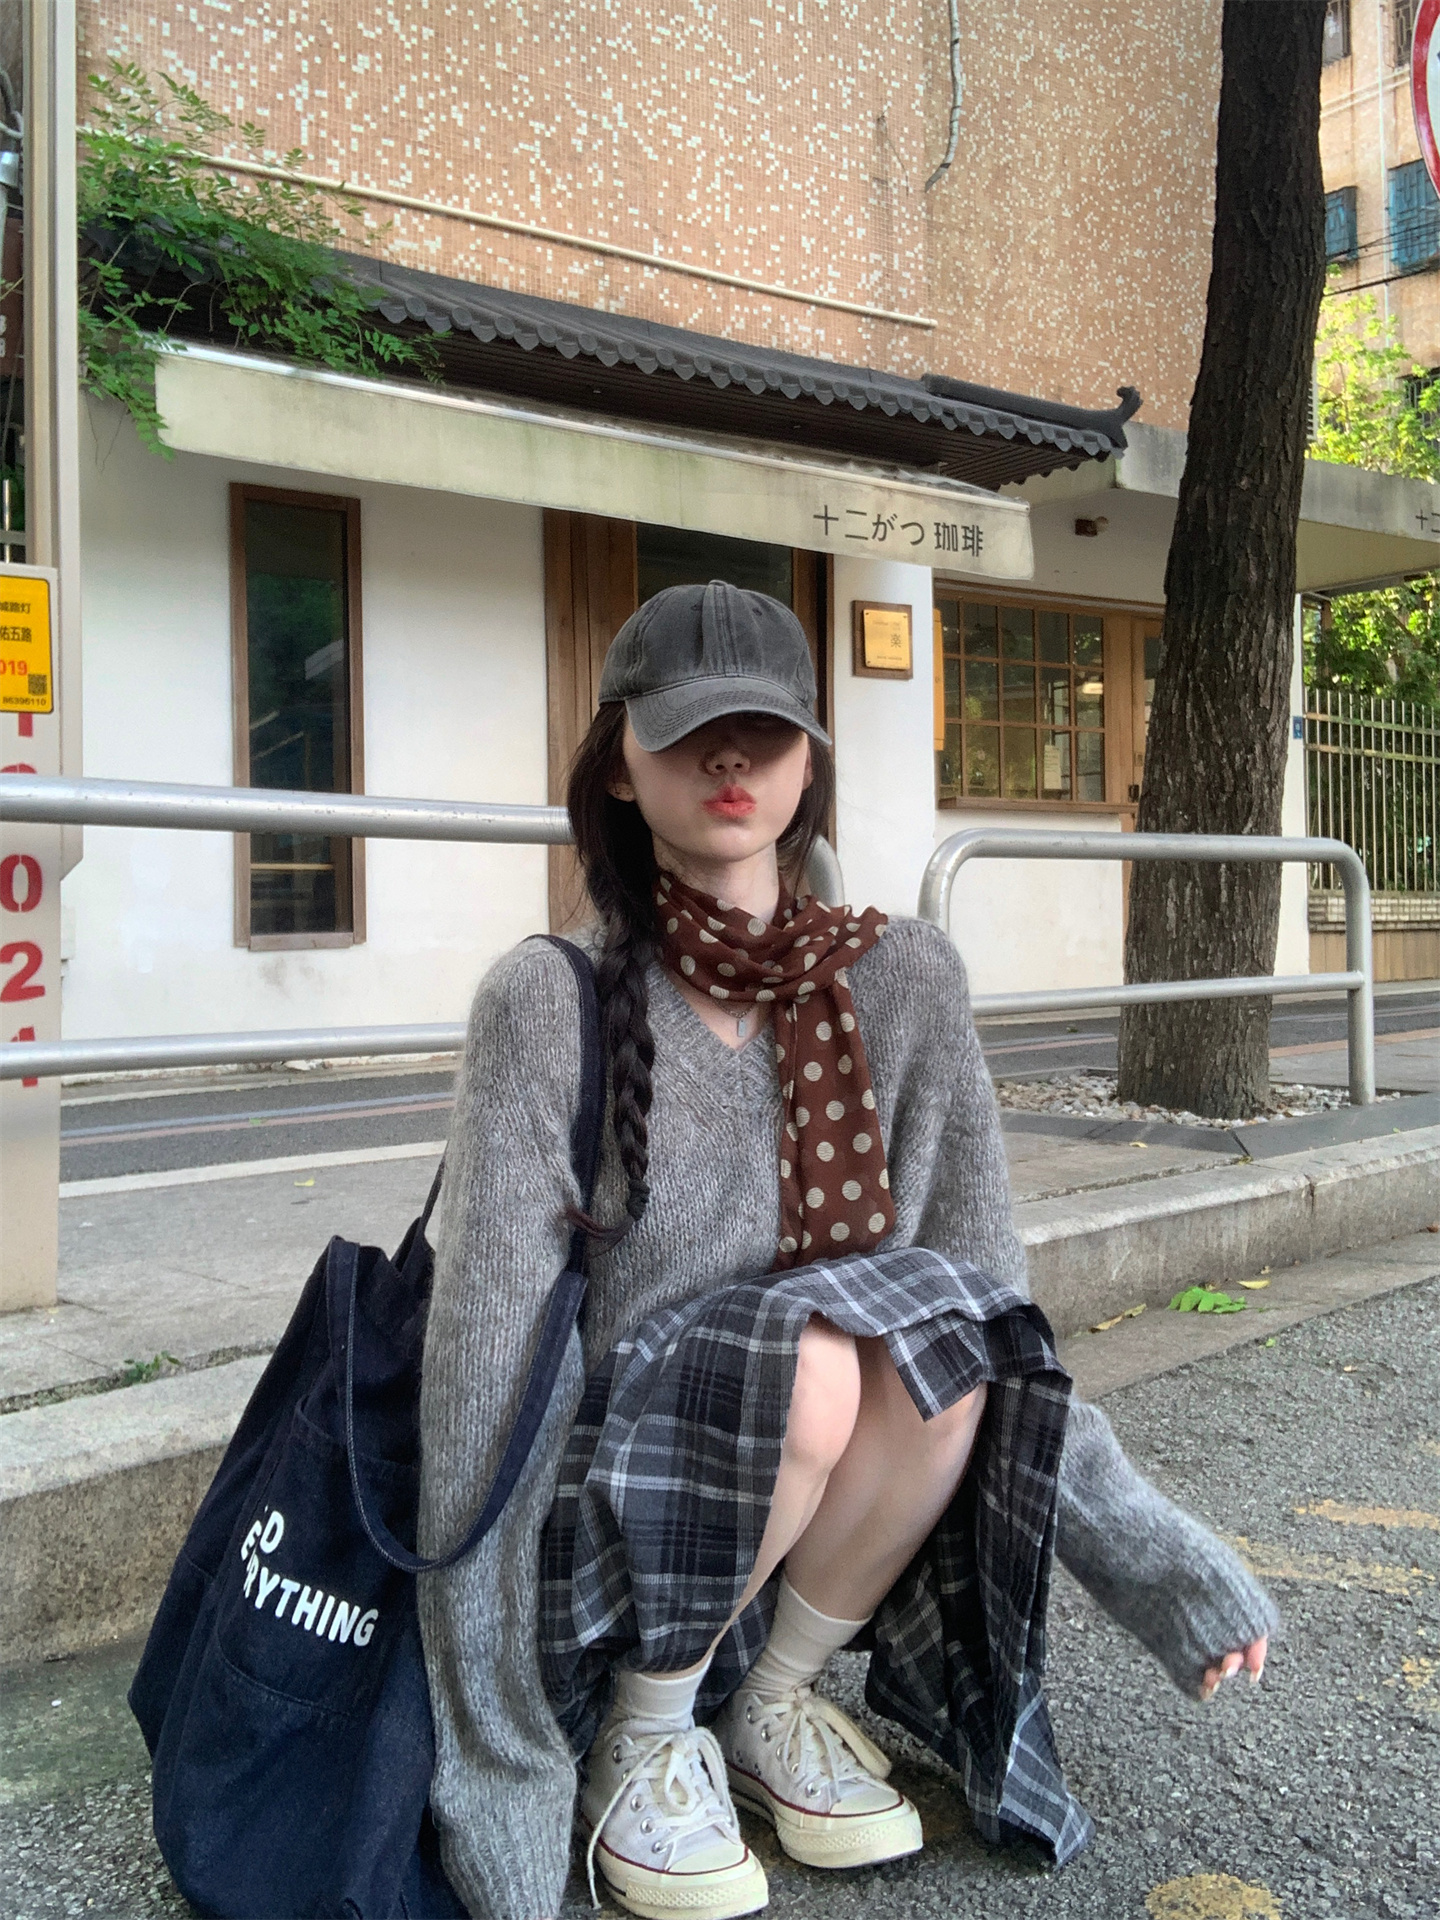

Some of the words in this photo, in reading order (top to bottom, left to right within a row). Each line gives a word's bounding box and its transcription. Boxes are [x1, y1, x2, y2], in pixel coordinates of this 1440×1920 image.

[812, 503, 926, 547] 十二がつ
[933, 521, 985, 558] 珈琲
